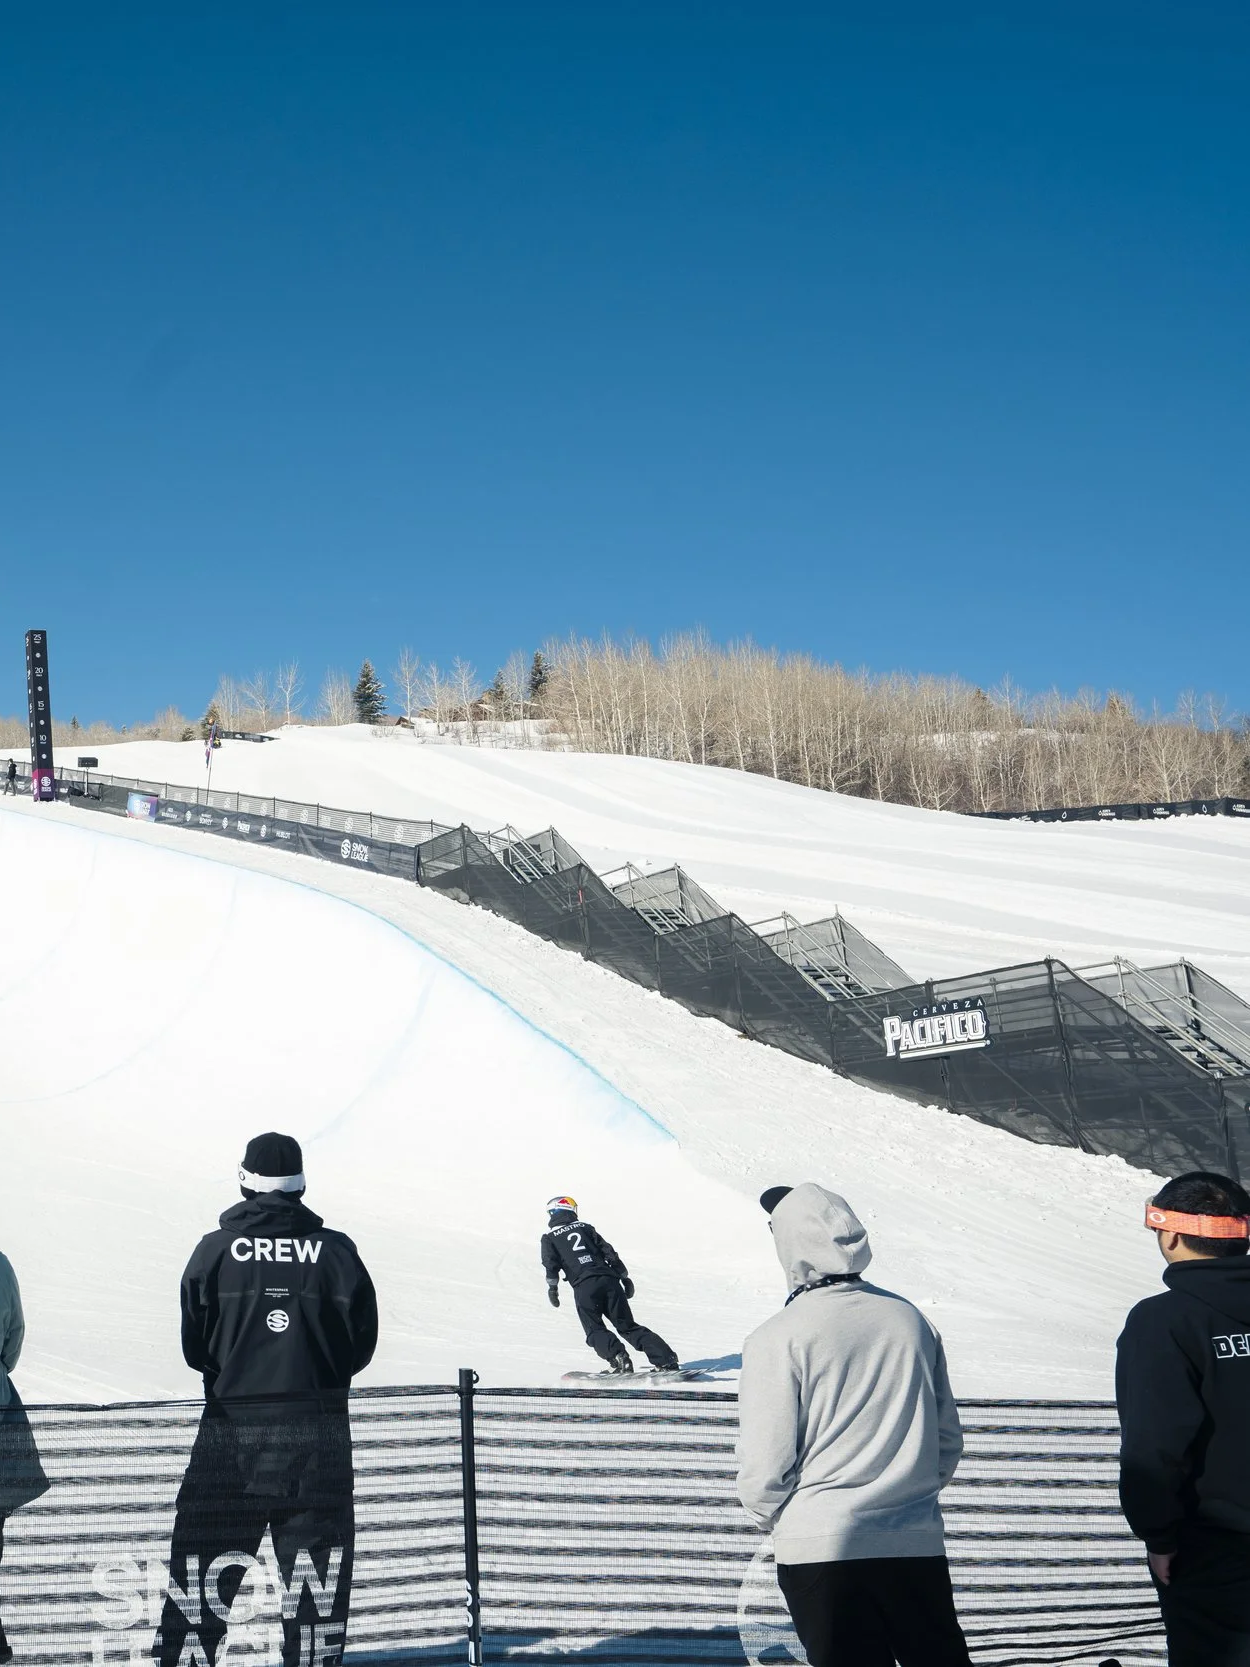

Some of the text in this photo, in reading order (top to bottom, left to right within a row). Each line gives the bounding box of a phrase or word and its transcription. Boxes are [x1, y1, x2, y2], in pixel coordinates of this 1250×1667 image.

[350, 850, 369, 862] LEAGUE
[352, 842, 369, 854] SNOW
[913, 999, 983, 1017] CERVEZA
[882, 1009, 987, 1056] PACIFICO
[553, 1223, 586, 1236] MASTRO
[231, 1237, 323, 1264] CREW
[567, 1232, 586, 1251] 2
[91, 1547, 344, 1630] SNOW
